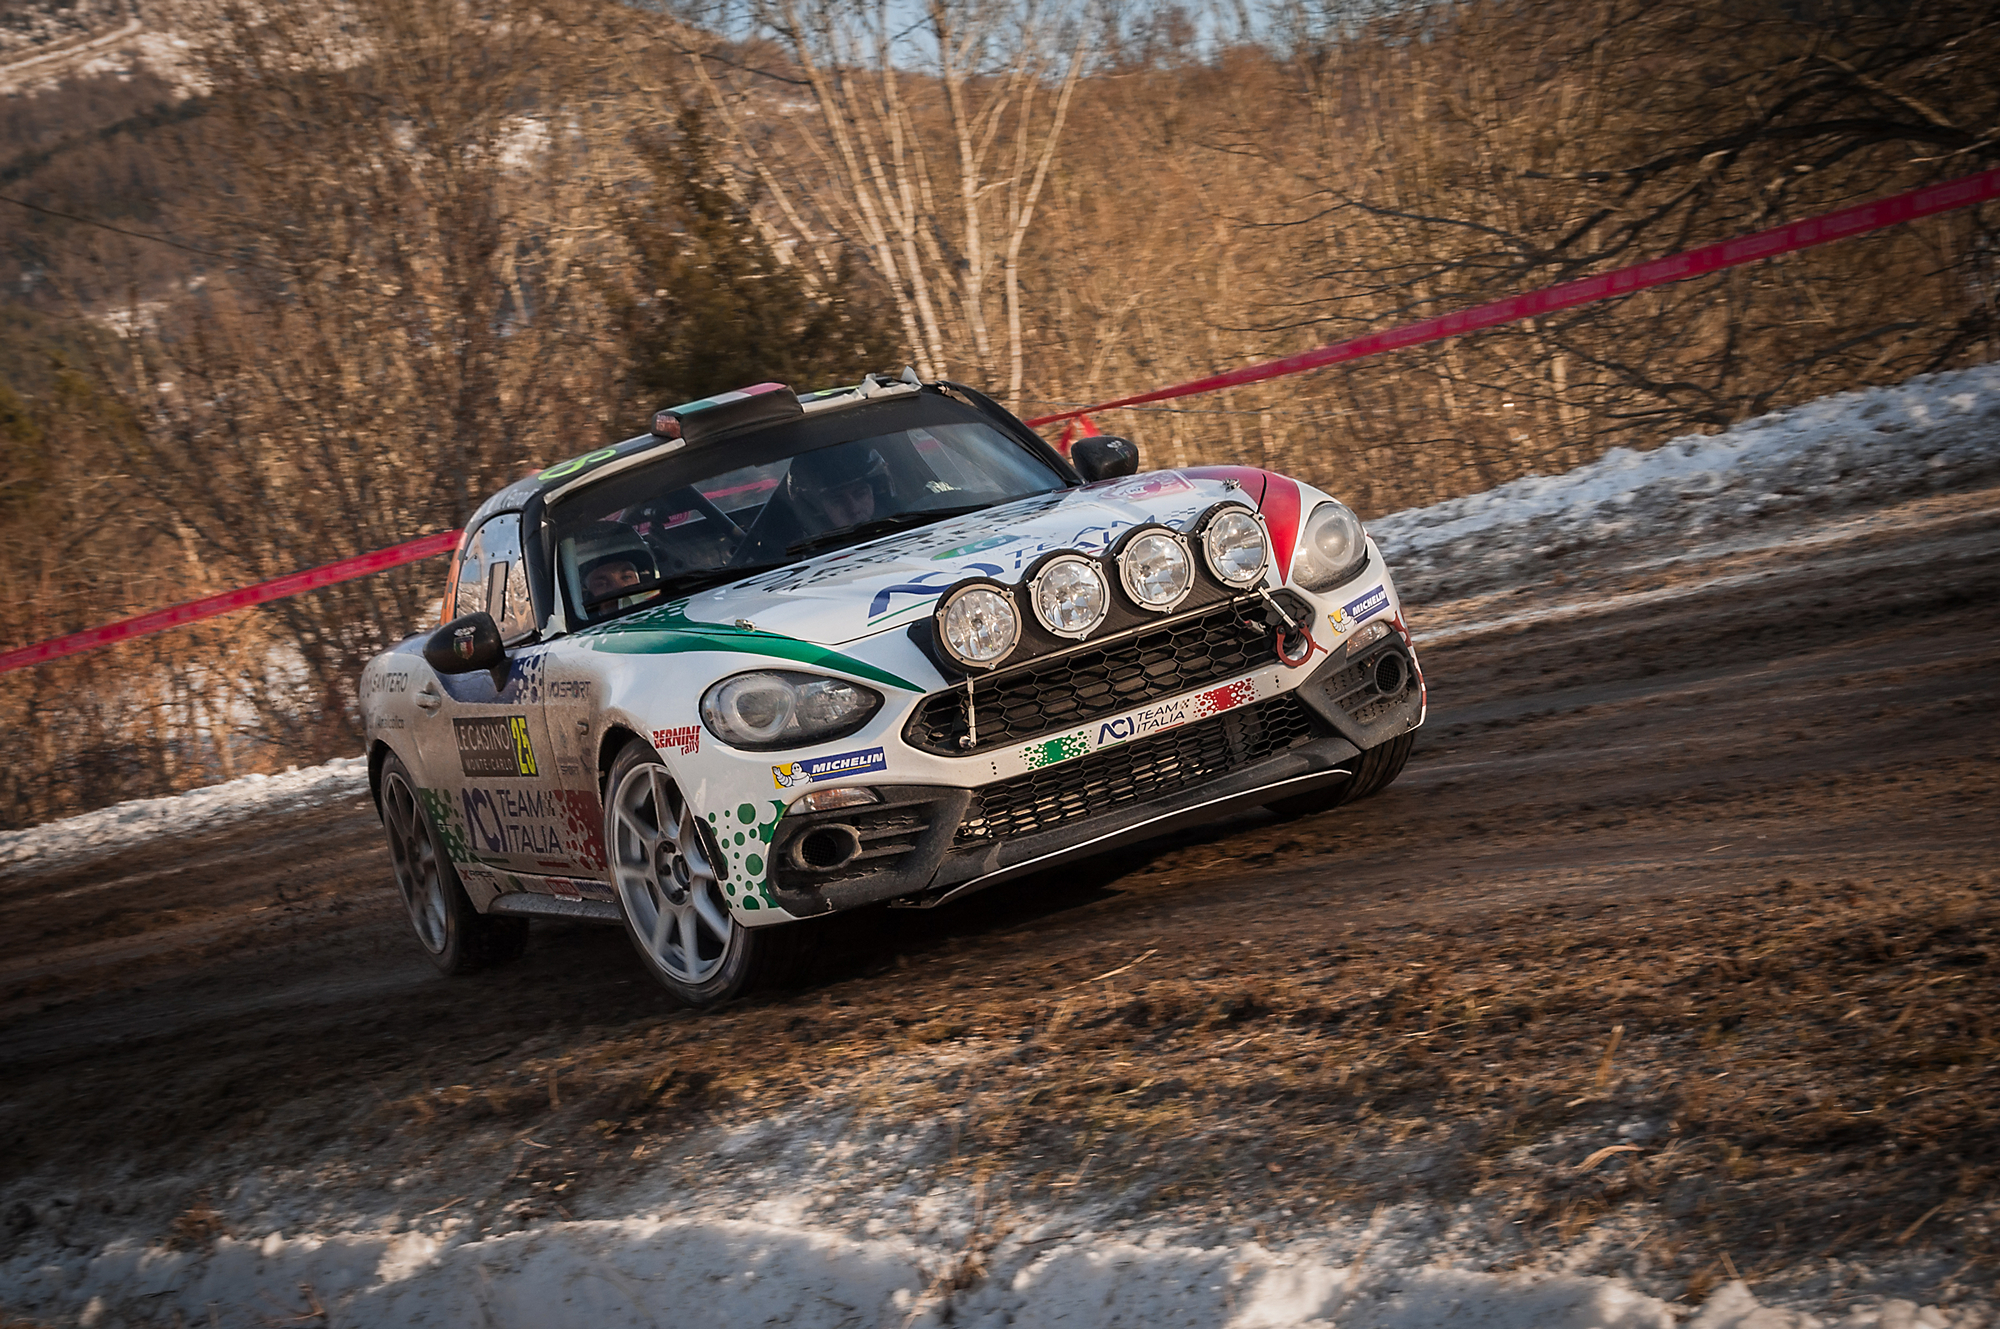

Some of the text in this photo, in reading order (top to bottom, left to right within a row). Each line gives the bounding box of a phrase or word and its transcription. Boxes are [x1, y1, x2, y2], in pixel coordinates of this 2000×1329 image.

[1352, 590, 1386, 616] MICHELIN
[1137, 701, 1179, 722] TEAM
[455, 724, 510, 751] LE CASINO
[652, 725, 701, 749] BERNINI
[1097, 710, 1185, 745] ACI ITALIA
[510, 717, 537, 775] 25
[680, 740, 700, 756] rally
[465, 758, 514, 771] MONTE-CARLO
[811, 753, 884, 774] MICHELIN
[496, 789, 545, 818] TEAM
[505, 824, 564, 855] ITALIA
